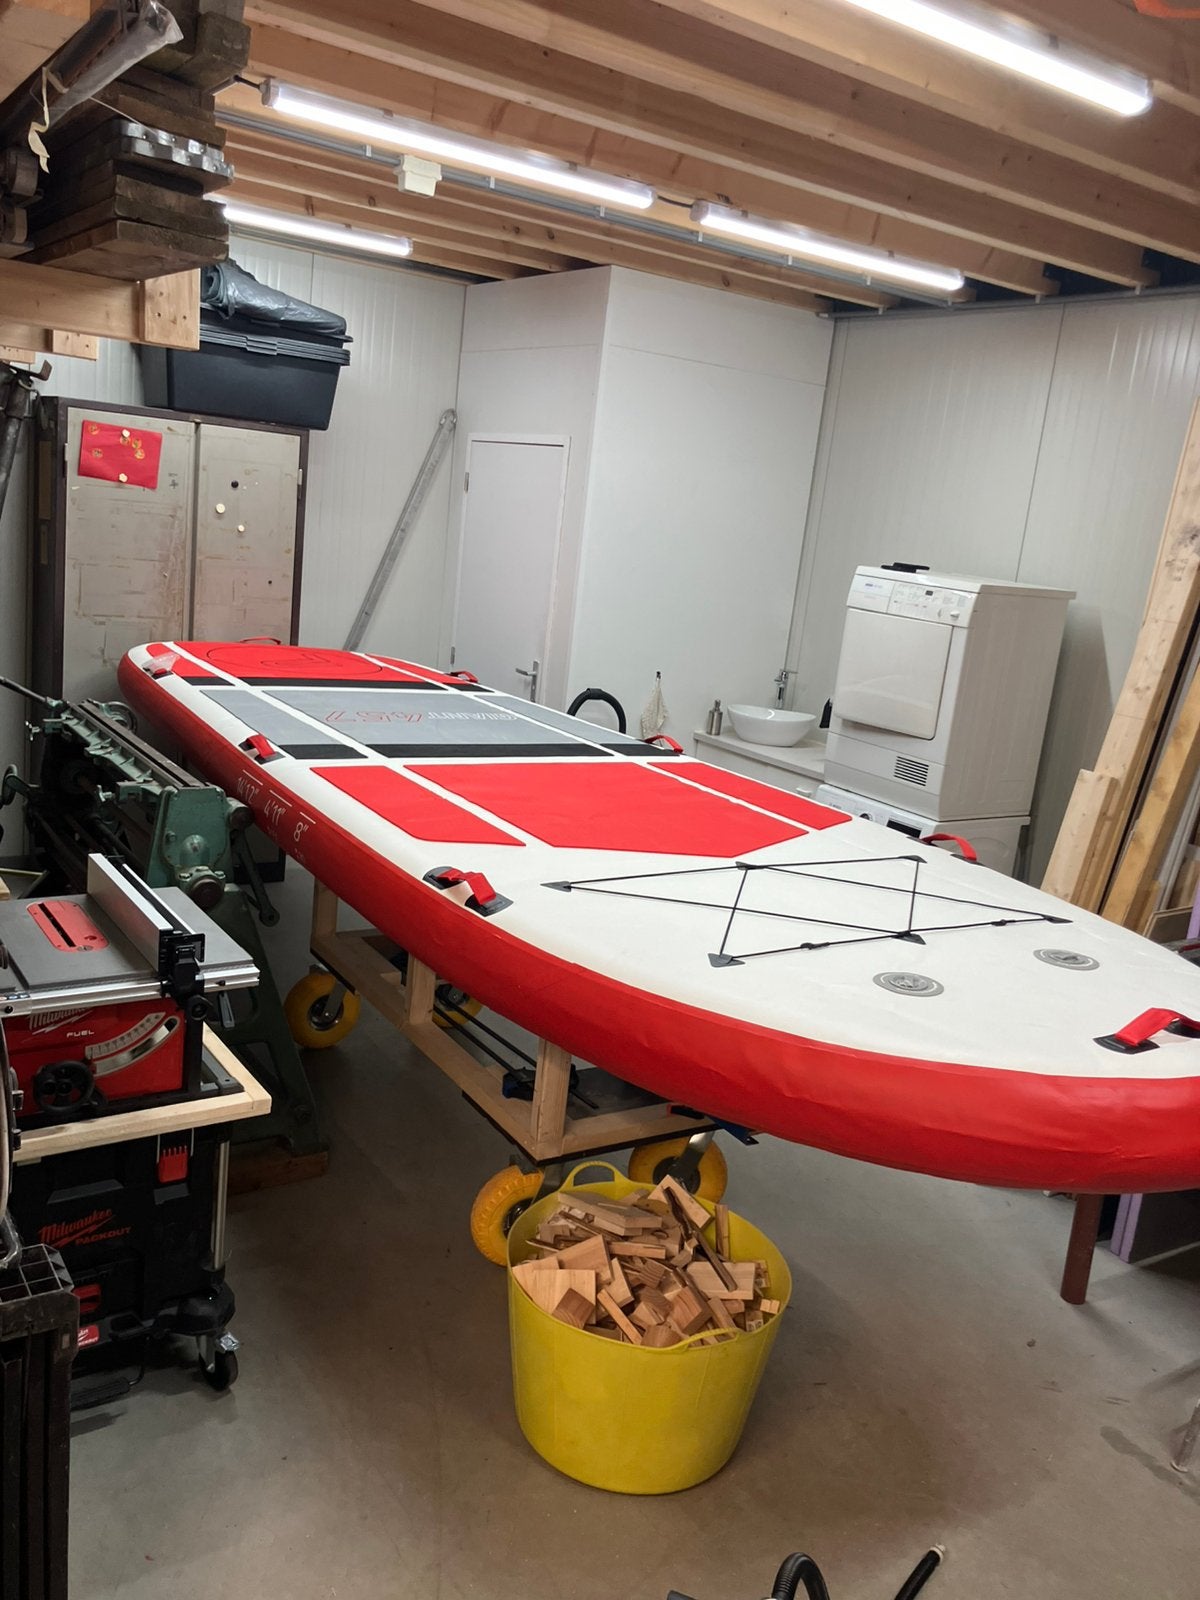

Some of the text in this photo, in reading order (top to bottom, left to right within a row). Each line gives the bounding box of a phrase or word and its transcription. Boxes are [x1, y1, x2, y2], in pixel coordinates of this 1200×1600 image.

[66, 1030, 95, 1038] FUEL
[38, 1208, 113, 1244] Milwaukee
[75, 1227, 131, 1245] PACKOUT
